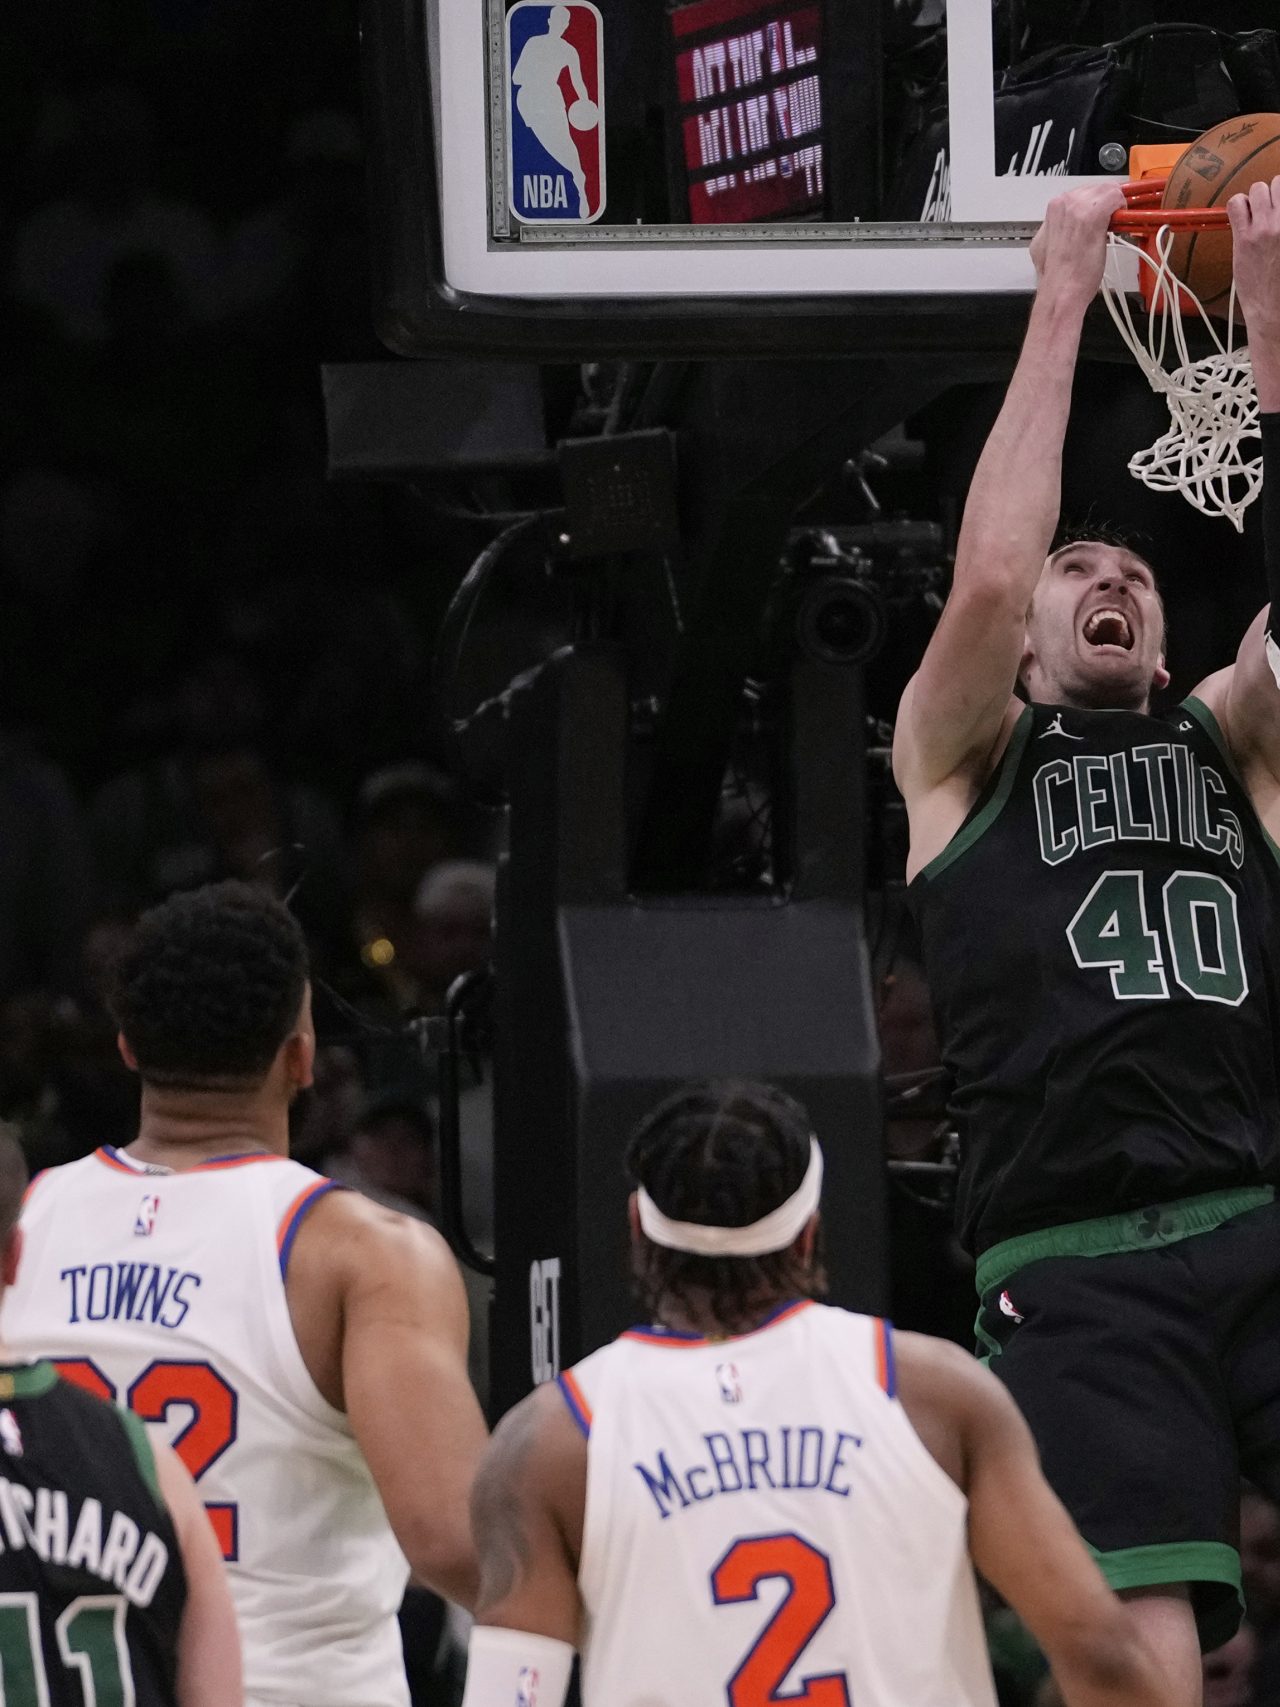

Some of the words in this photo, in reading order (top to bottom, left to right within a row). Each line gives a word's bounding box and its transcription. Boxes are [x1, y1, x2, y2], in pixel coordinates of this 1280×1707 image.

[523, 174, 568, 209] NBA
[1066, 870, 1249, 1007] 40
[61, 1262, 202, 1329] TOWNS
[38, 1358, 238, 1562] 2
[634, 1427, 861, 1519] McBRIDE
[0, 1476, 169, 1607] TCHARD
[711, 1531, 851, 1707] 2
